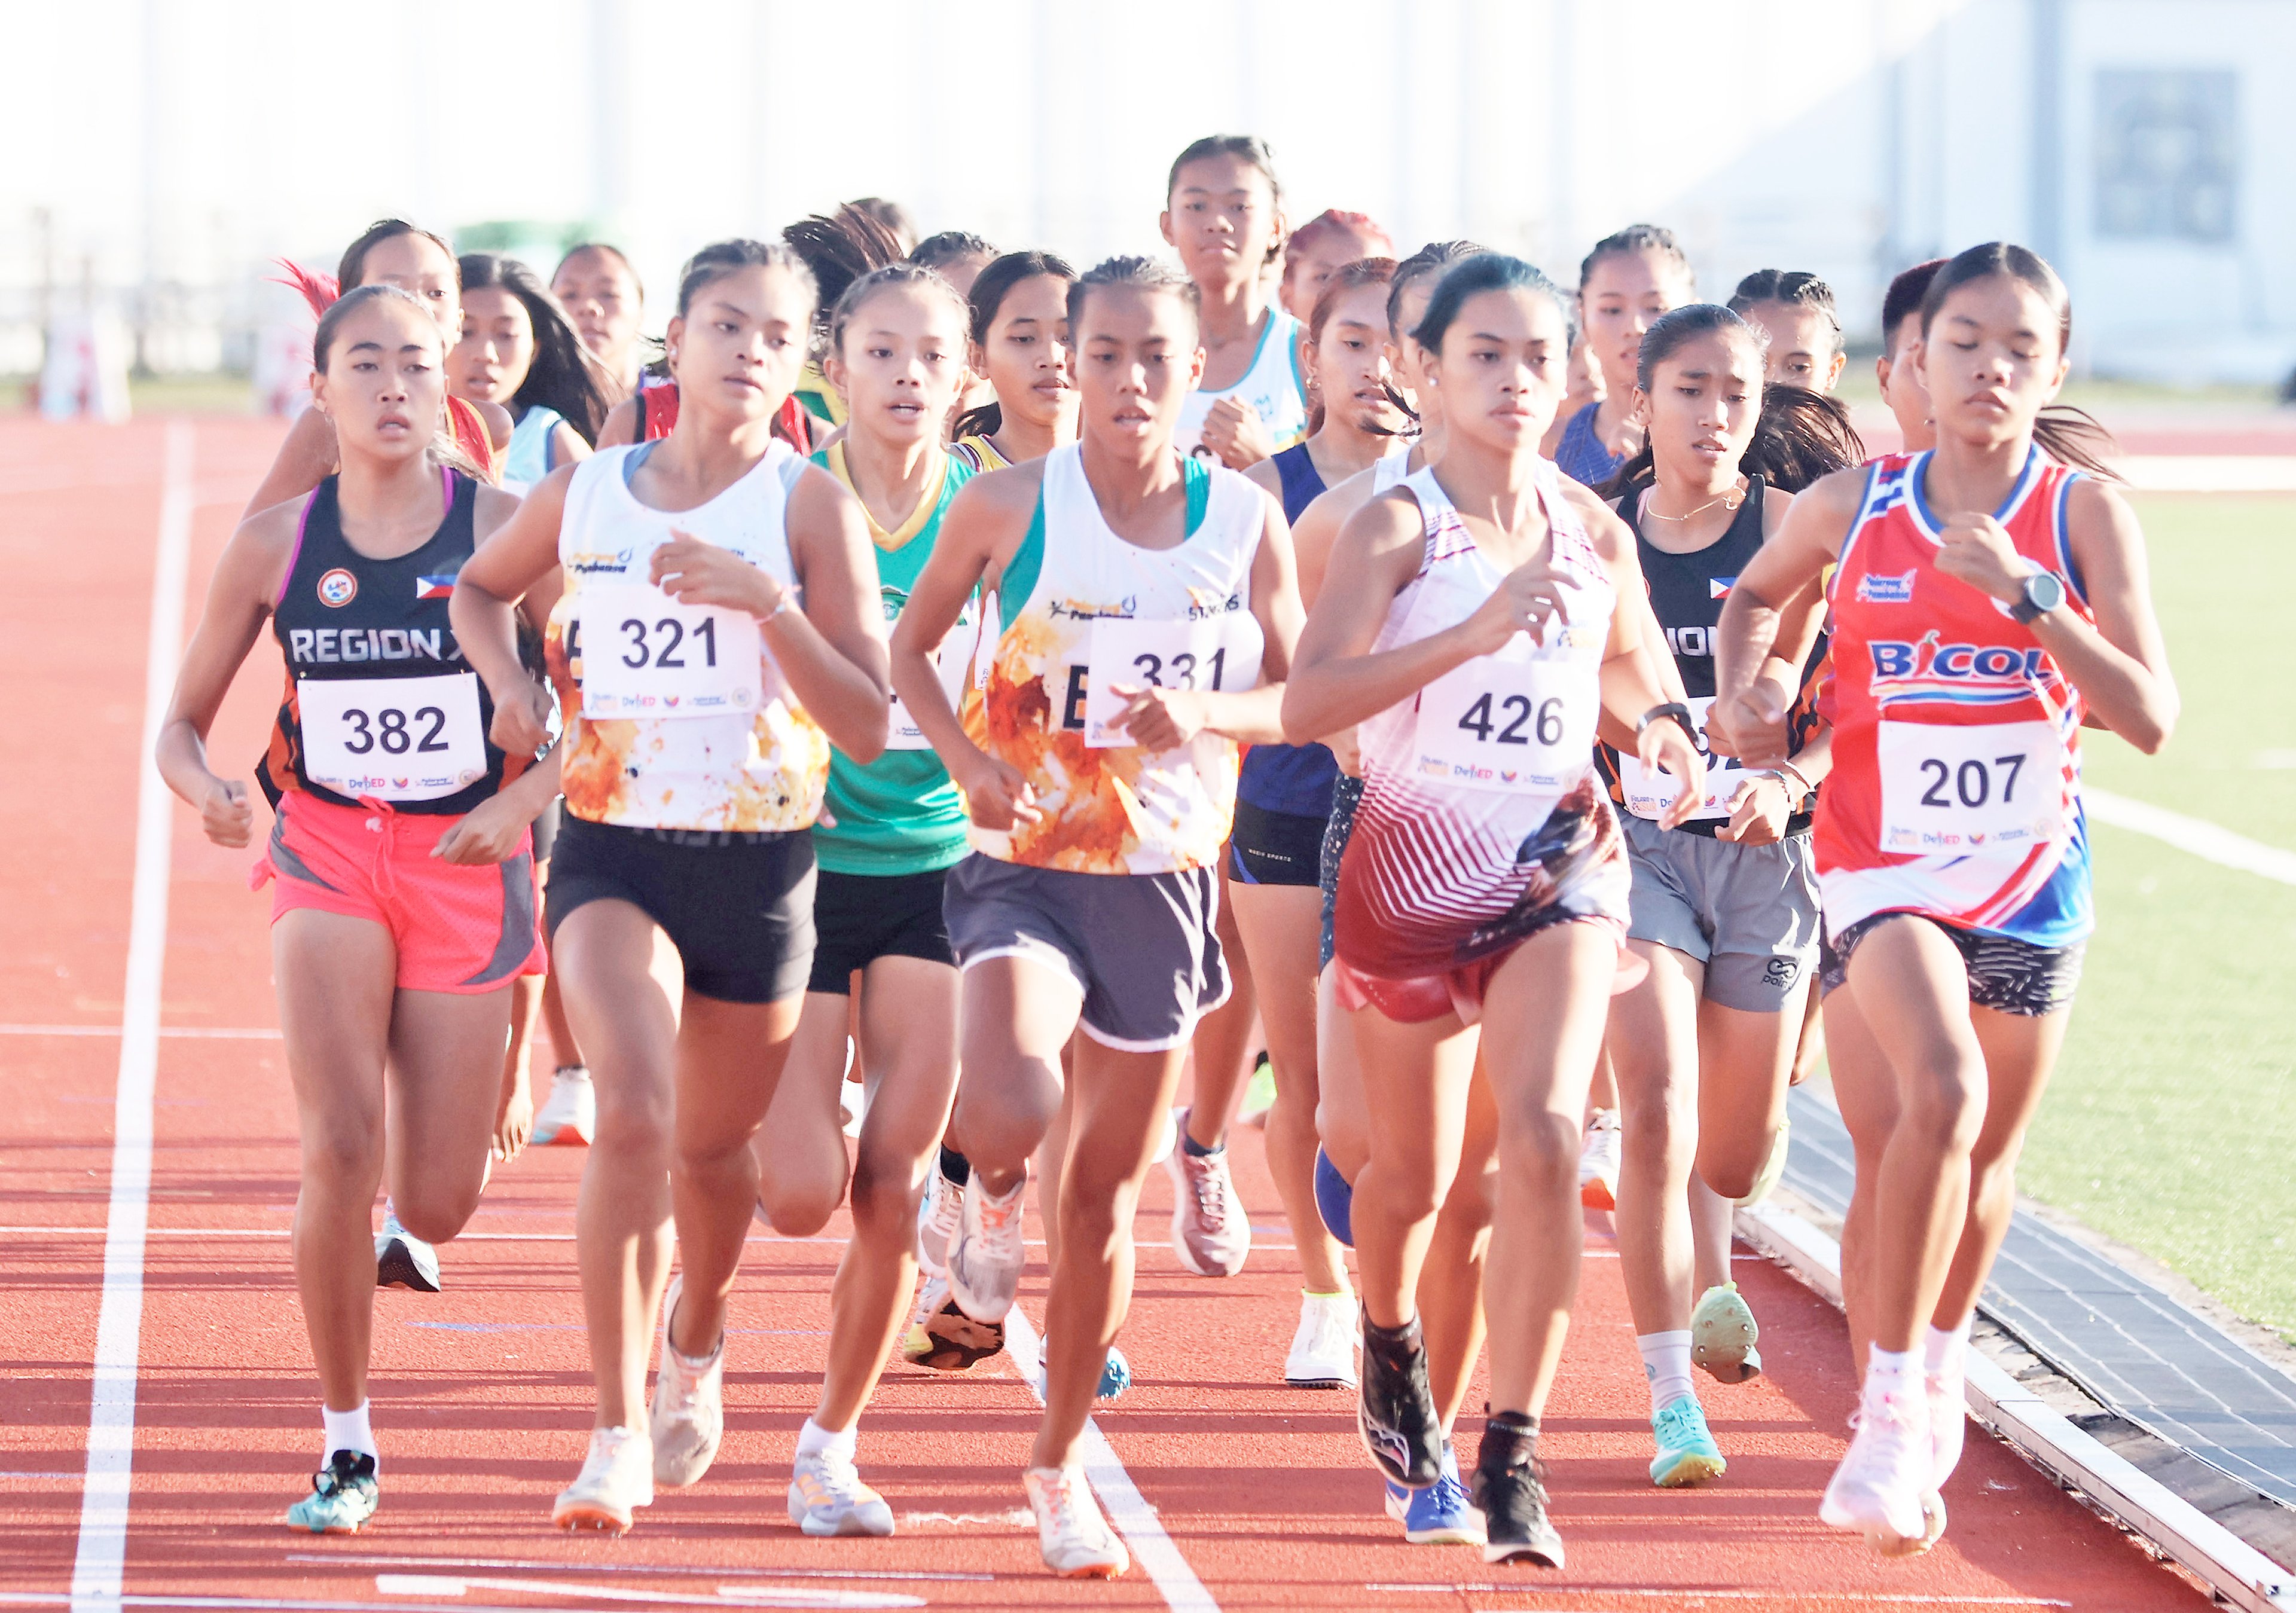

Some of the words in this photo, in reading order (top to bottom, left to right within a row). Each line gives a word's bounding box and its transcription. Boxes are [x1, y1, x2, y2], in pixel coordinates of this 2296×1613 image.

[289, 628, 441, 663] REGION
[621, 616, 716, 668] 321
[1871, 631, 2053, 680] BICOL
[1133, 647, 1226, 692] 331
[341, 705, 450, 754] 382
[1457, 692, 1565, 746] 426
[349, 775, 386, 792] DepED
[1920, 753, 2026, 808] 207
